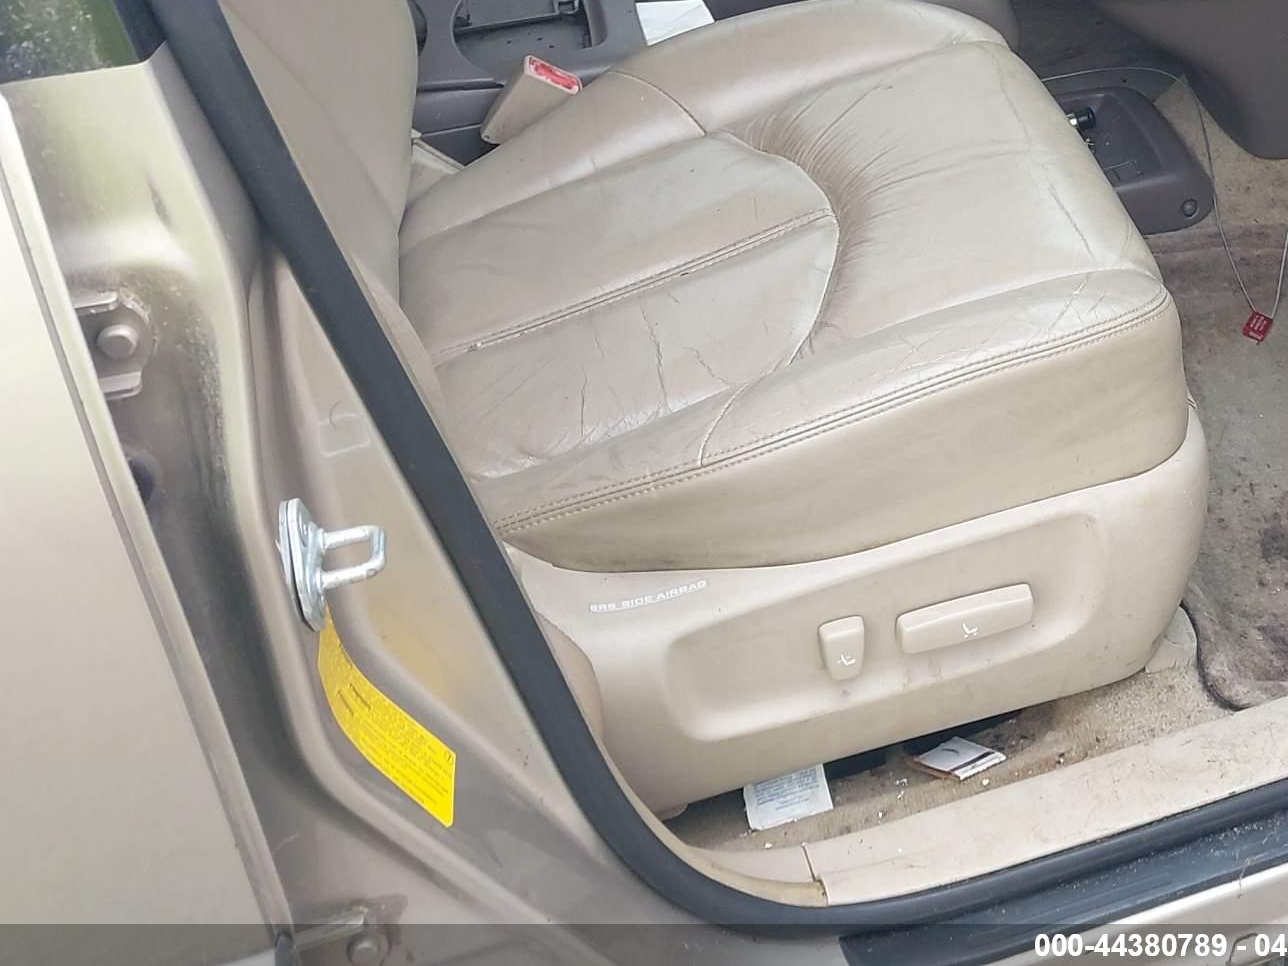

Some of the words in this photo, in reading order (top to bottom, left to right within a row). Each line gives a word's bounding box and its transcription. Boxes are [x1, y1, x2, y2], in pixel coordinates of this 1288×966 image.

[589, 602, 617, 612] SRS
[622, 595, 653, 608] SIDE
[656, 579, 707, 601] AIRBAG
